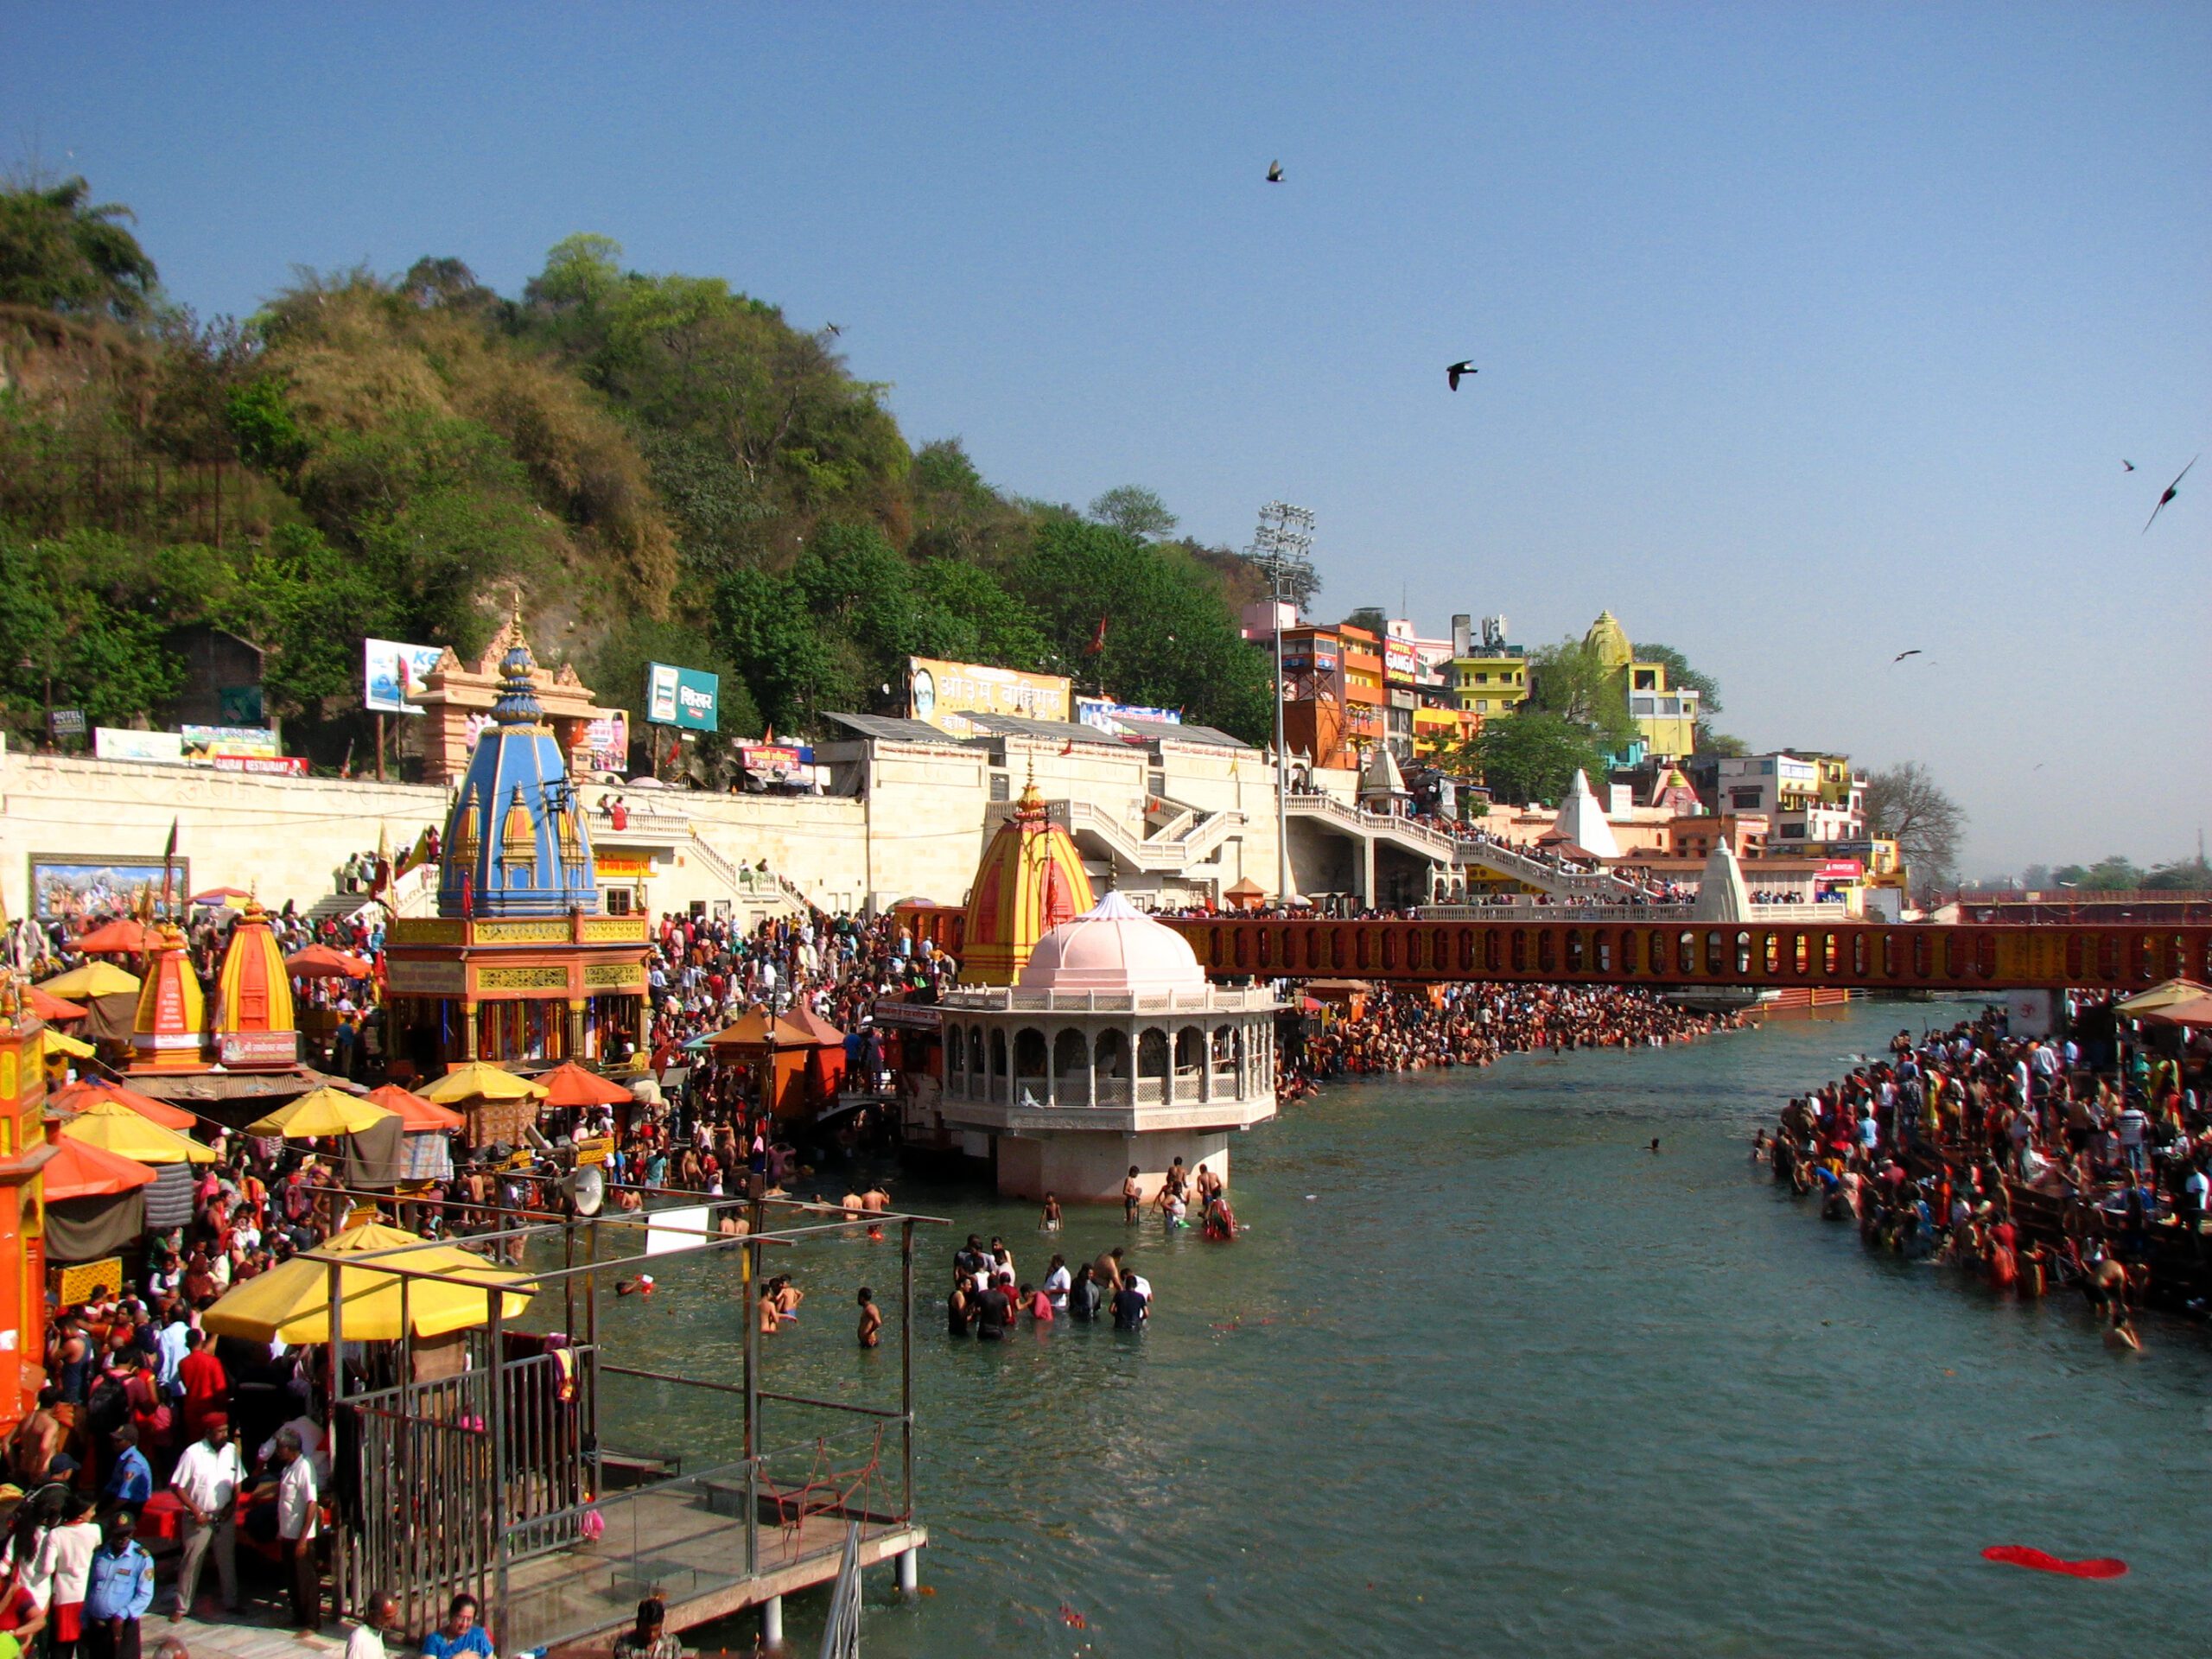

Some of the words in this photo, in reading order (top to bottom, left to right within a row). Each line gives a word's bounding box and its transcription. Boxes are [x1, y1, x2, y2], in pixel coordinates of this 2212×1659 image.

[1389, 641, 1413, 655] HOTEL
[1386, 651, 1415, 673] GANGA
[680, 685, 713, 709] शिखर
[53, 710, 81, 720] HOTEL
[245, 760, 289, 772] RESTAURANT
